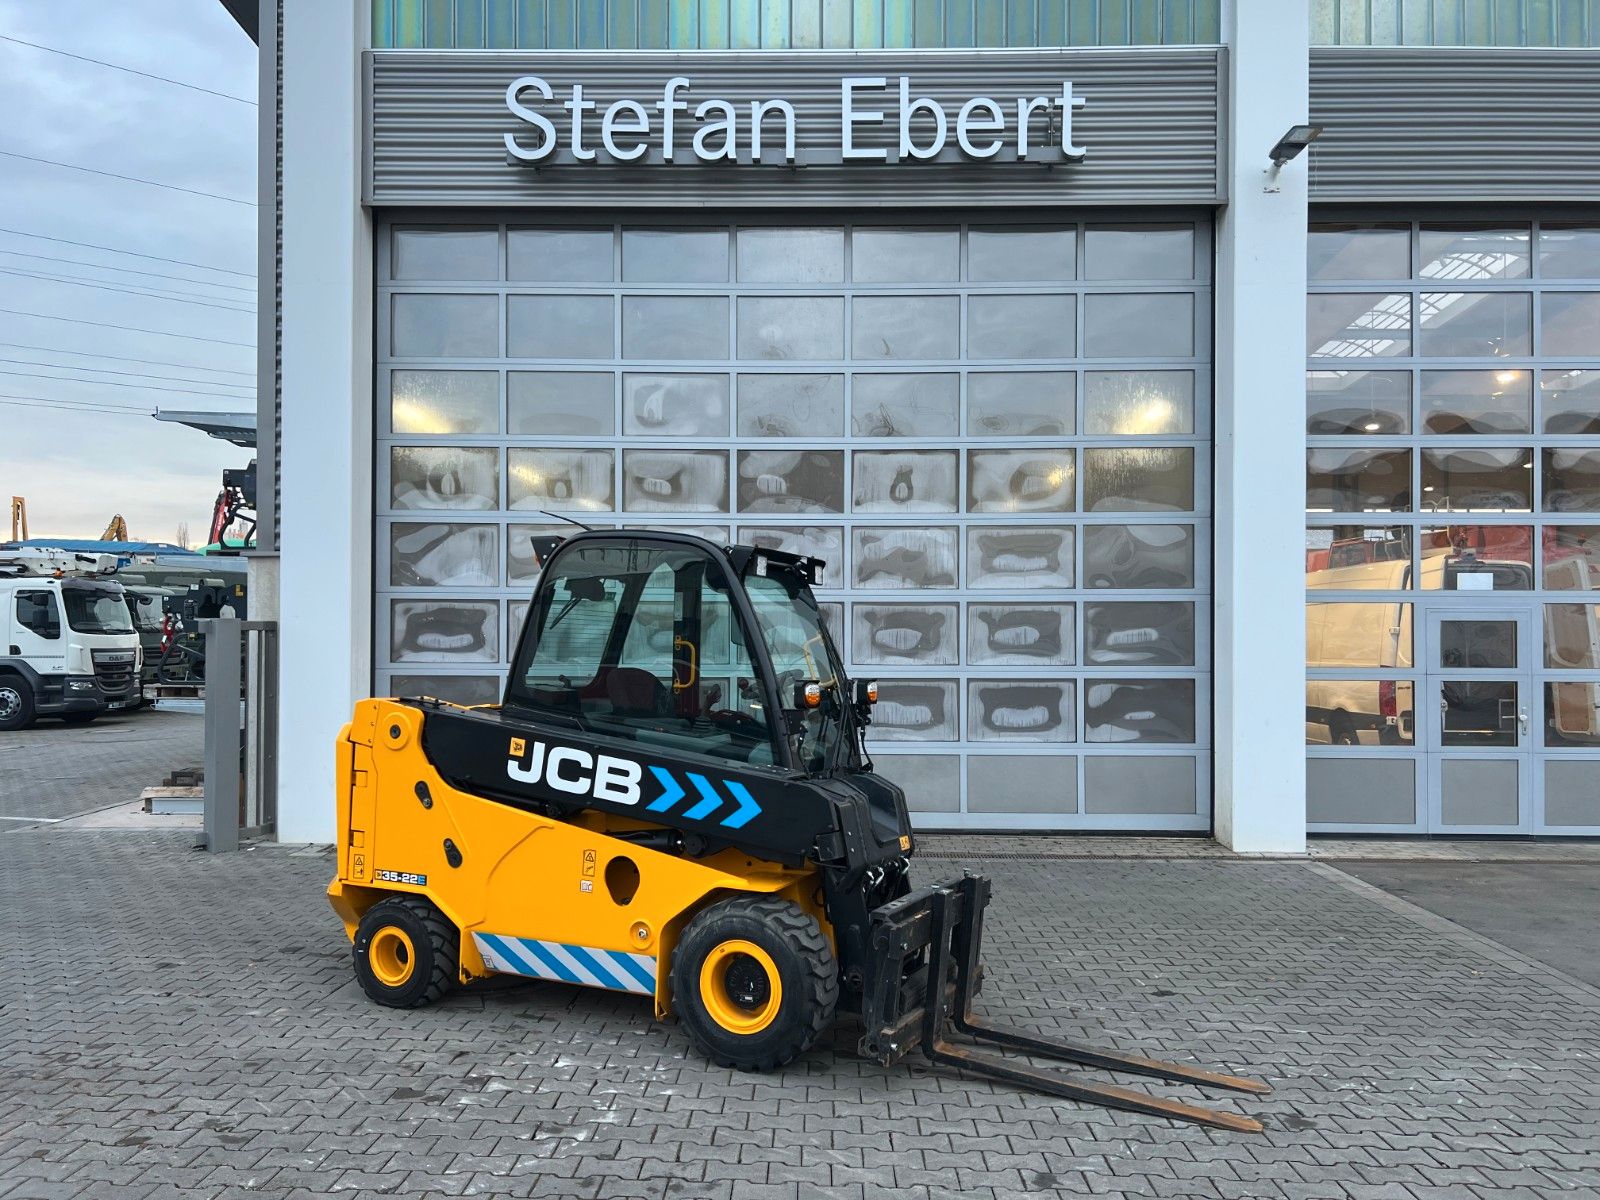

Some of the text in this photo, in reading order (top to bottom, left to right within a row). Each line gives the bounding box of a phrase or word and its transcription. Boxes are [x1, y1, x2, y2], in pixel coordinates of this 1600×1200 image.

[503, 76, 1087, 164] Stefan Ebert
[507, 741, 642, 805] JCB
